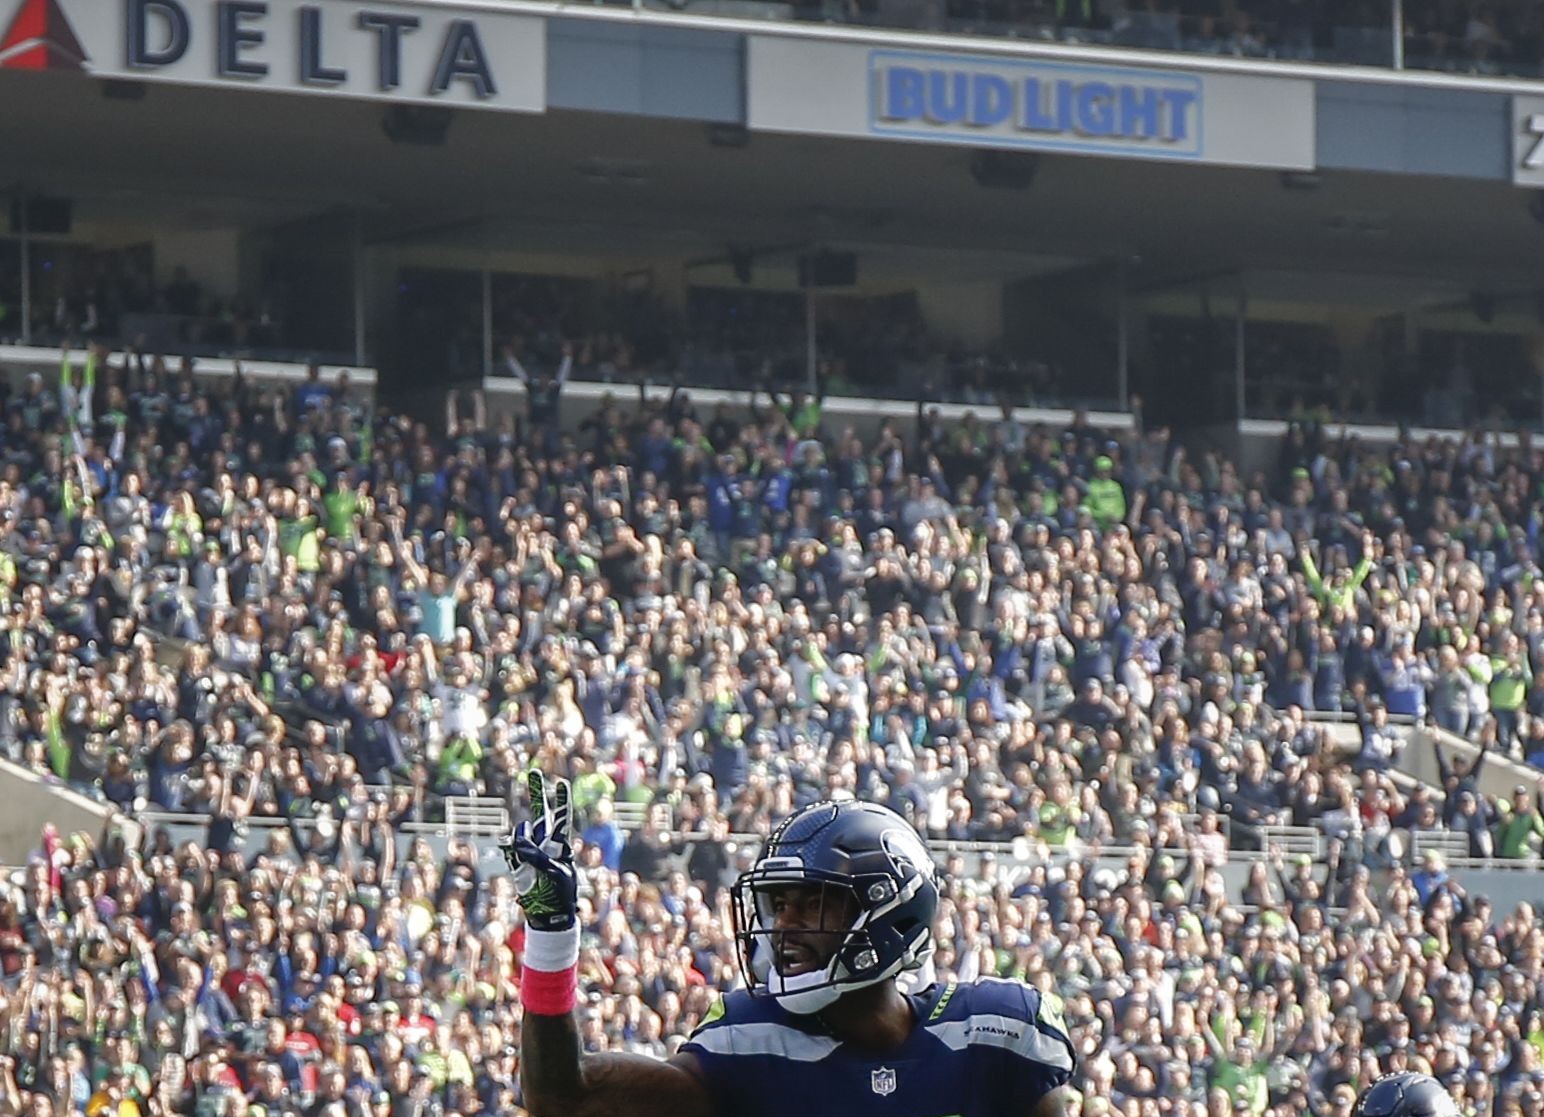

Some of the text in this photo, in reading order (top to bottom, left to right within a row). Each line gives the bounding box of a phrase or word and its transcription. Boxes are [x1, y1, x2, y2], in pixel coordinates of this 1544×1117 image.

[126, 0, 497, 98] DELTA
[882, 65, 1197, 142] BUD LIGHT
[963, 1024, 1021, 1041] SAHAWKS
